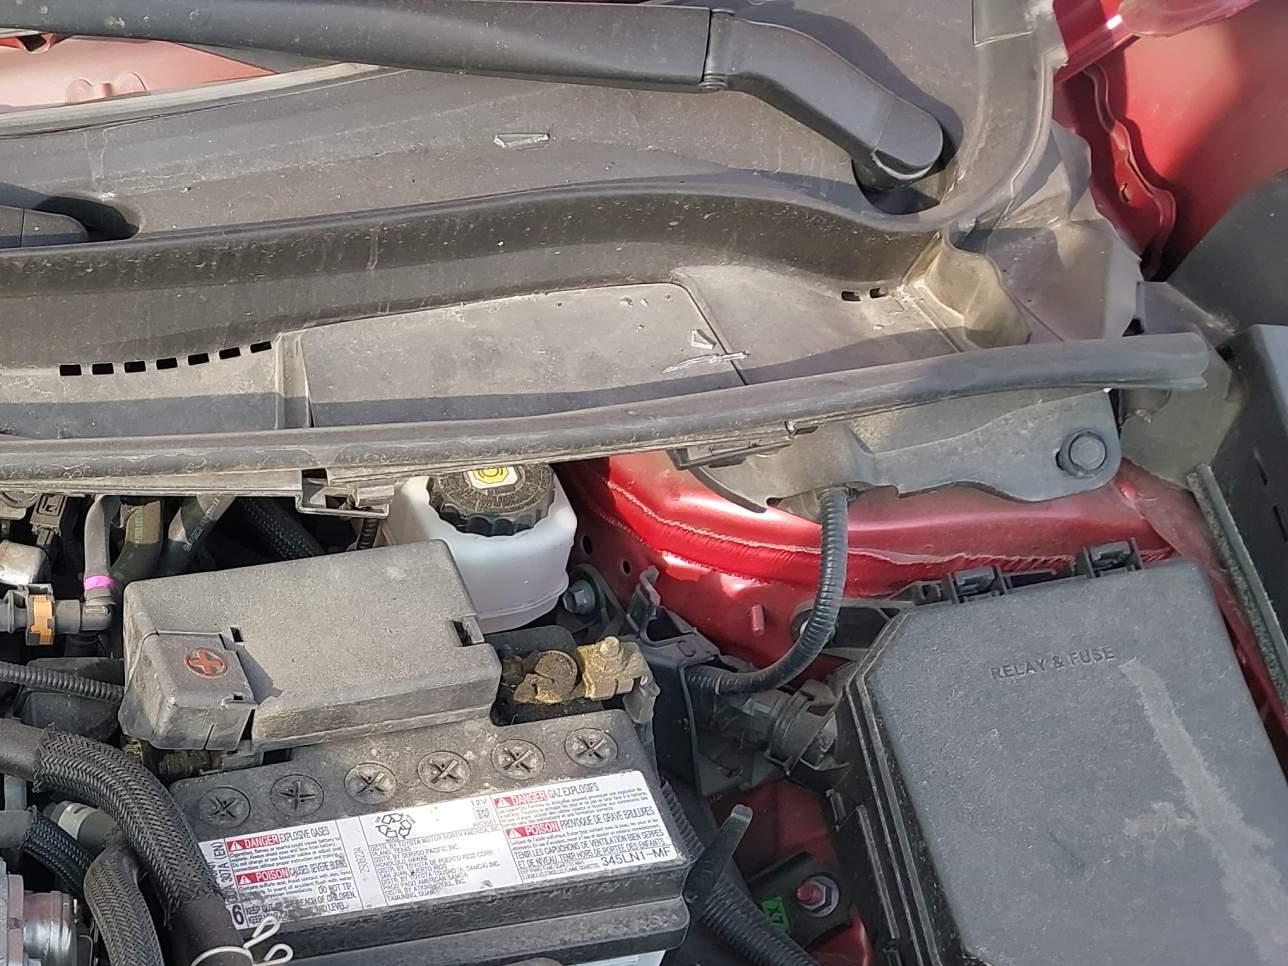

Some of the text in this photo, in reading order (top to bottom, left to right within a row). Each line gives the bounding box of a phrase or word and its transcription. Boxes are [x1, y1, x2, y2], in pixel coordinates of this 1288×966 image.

[990, 646, 1115, 680] RELAY & FUSE
[470, 798, 488, 806] 12V
[511, 791, 546, 805] DANGER
[547, 788, 563, 799] GAZ
[525, 822, 559, 835] POISON
[559, 816, 594, 830] PROVOQUE
[593, 815, 603, 824] DE
[244, 834, 279, 849] DANGER
[310, 826, 330, 837] GASES
[580, 841, 590, 849] DE
[601, 847, 673, 867] 345LN1-MF
[255, 868, 290, 882] POISON
[318, 886, 328, 895] DO
[328, 884, 341, 893] NOT
[231, 905, 245, 925] 6
